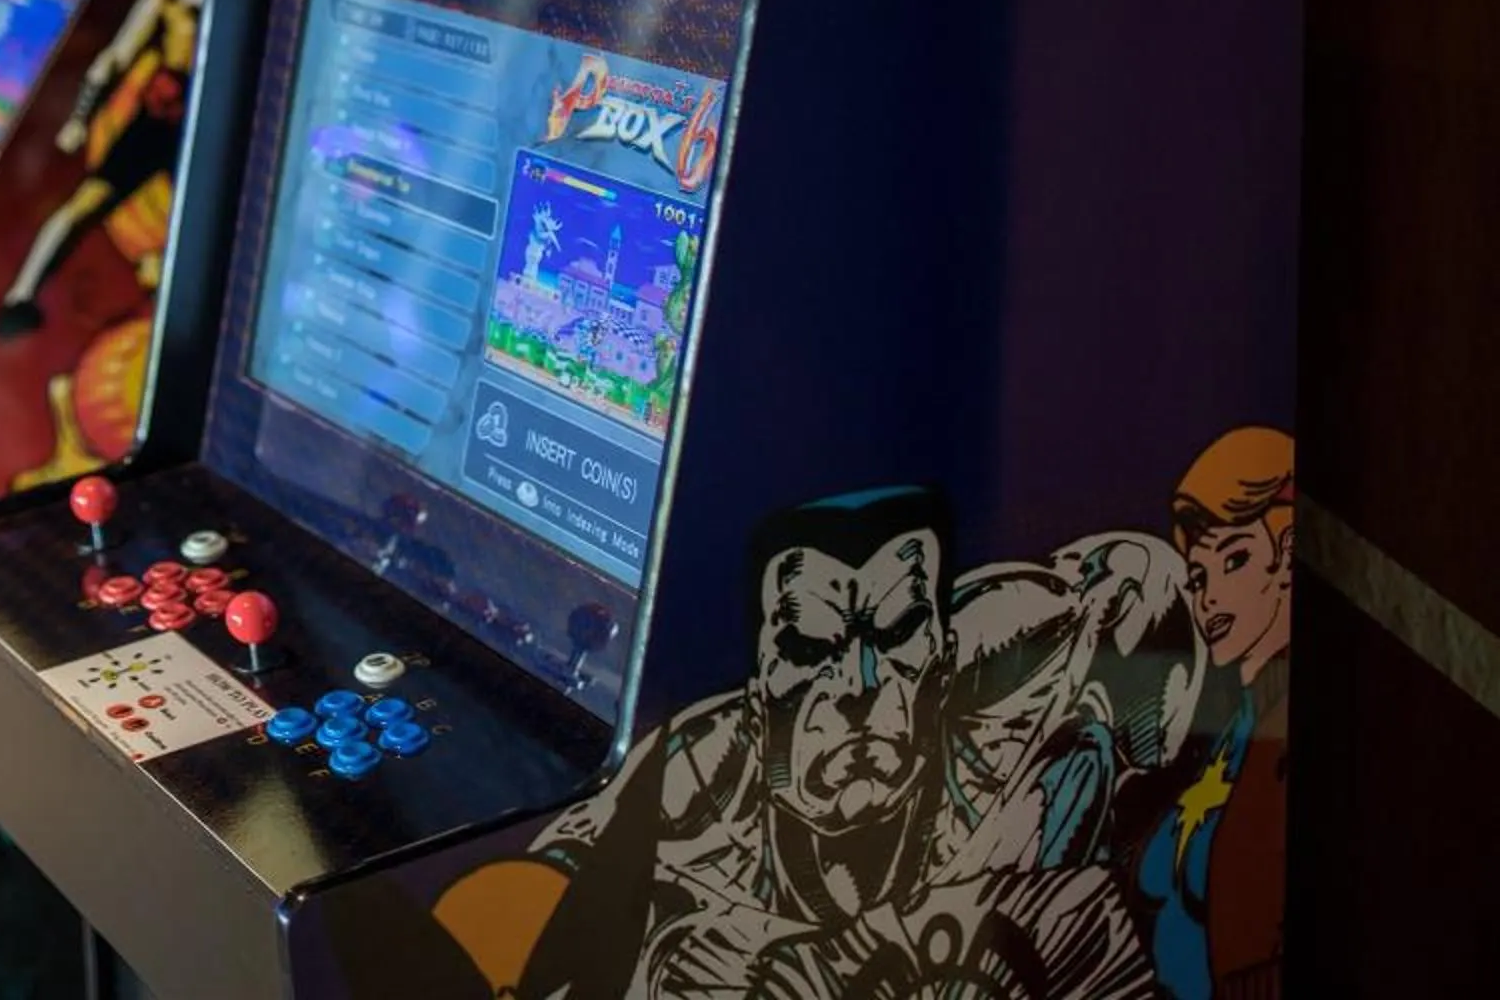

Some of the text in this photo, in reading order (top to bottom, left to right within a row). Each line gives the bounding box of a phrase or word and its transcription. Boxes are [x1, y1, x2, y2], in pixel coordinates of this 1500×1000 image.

[577, 95, 687, 174] BOX
[526, 429, 638, 504] INSERT COIN(S)
